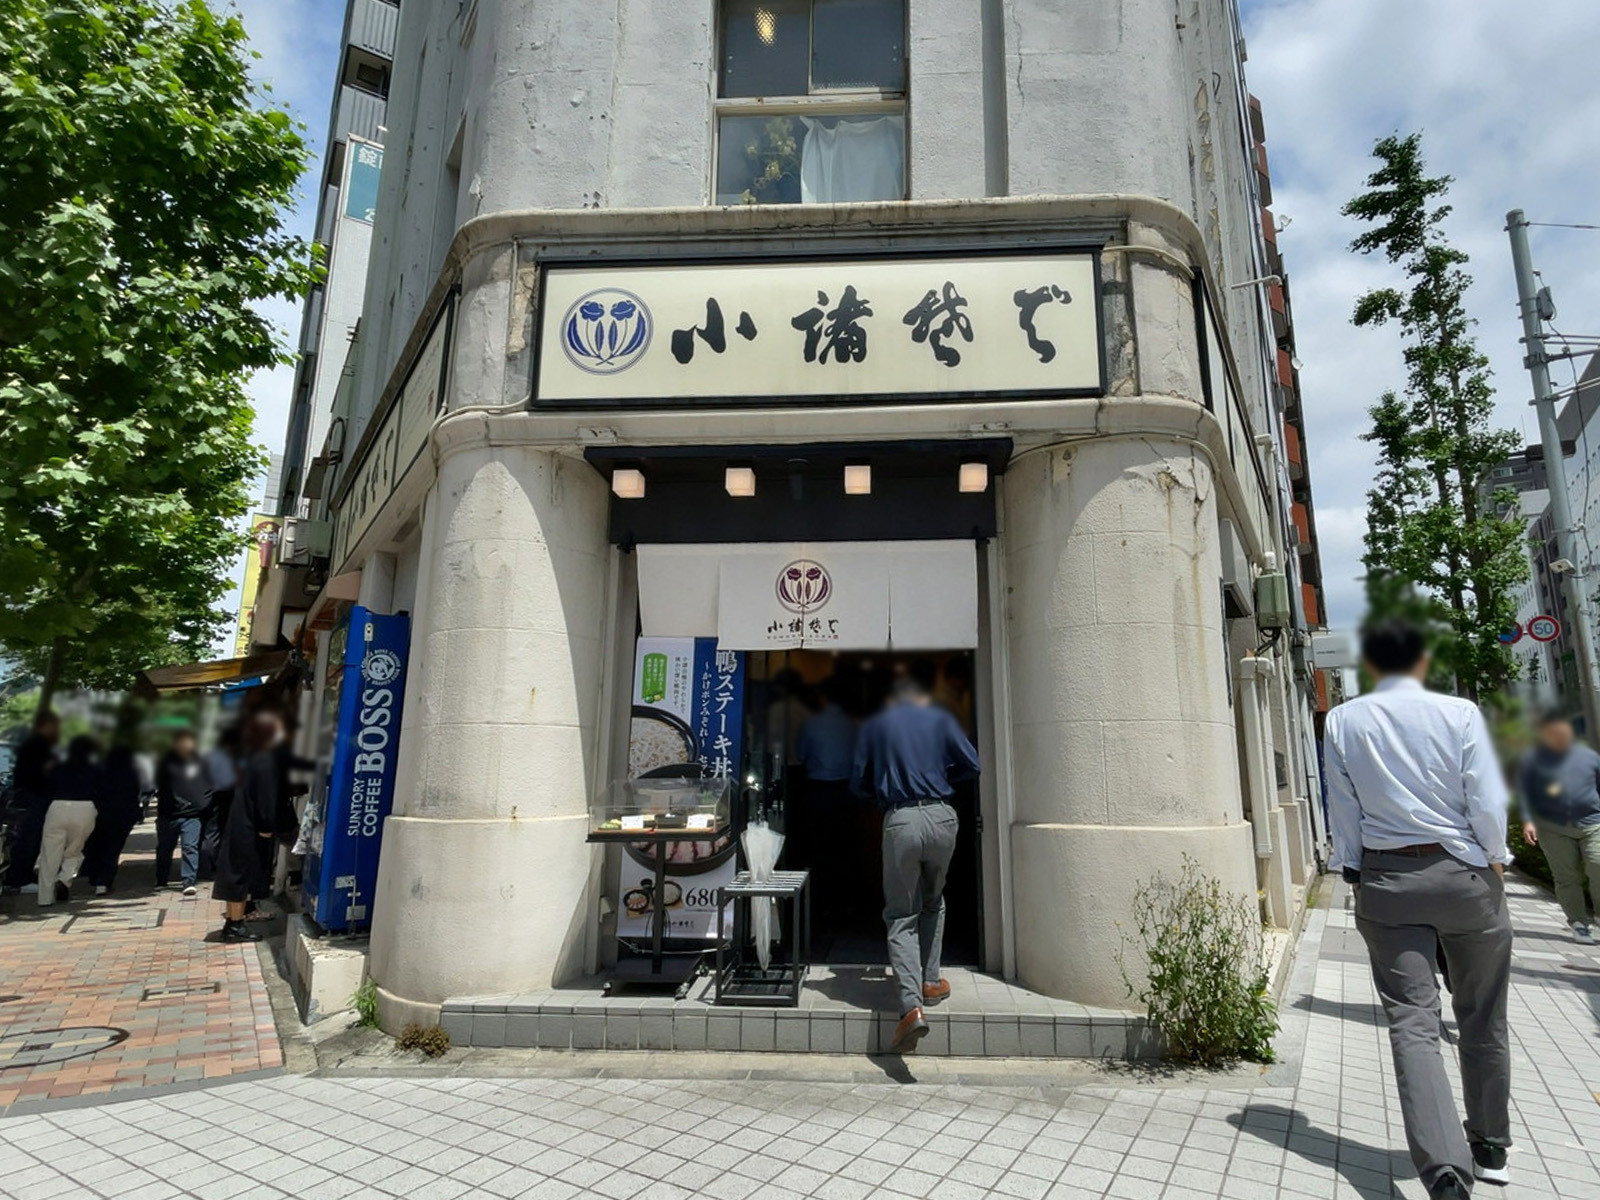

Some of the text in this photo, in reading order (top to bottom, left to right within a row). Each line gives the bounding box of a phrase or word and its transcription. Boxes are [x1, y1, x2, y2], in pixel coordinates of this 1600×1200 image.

[1534, 622, 1553, 635] 50
[354, 688, 393, 774] BOSS
[710, 649, 738, 780] 鴨ステーキ丼
[347, 777, 365, 836] SUNTORY
[362, 778, 382, 837] COFFEE
[685, 887, 719, 907] 680
